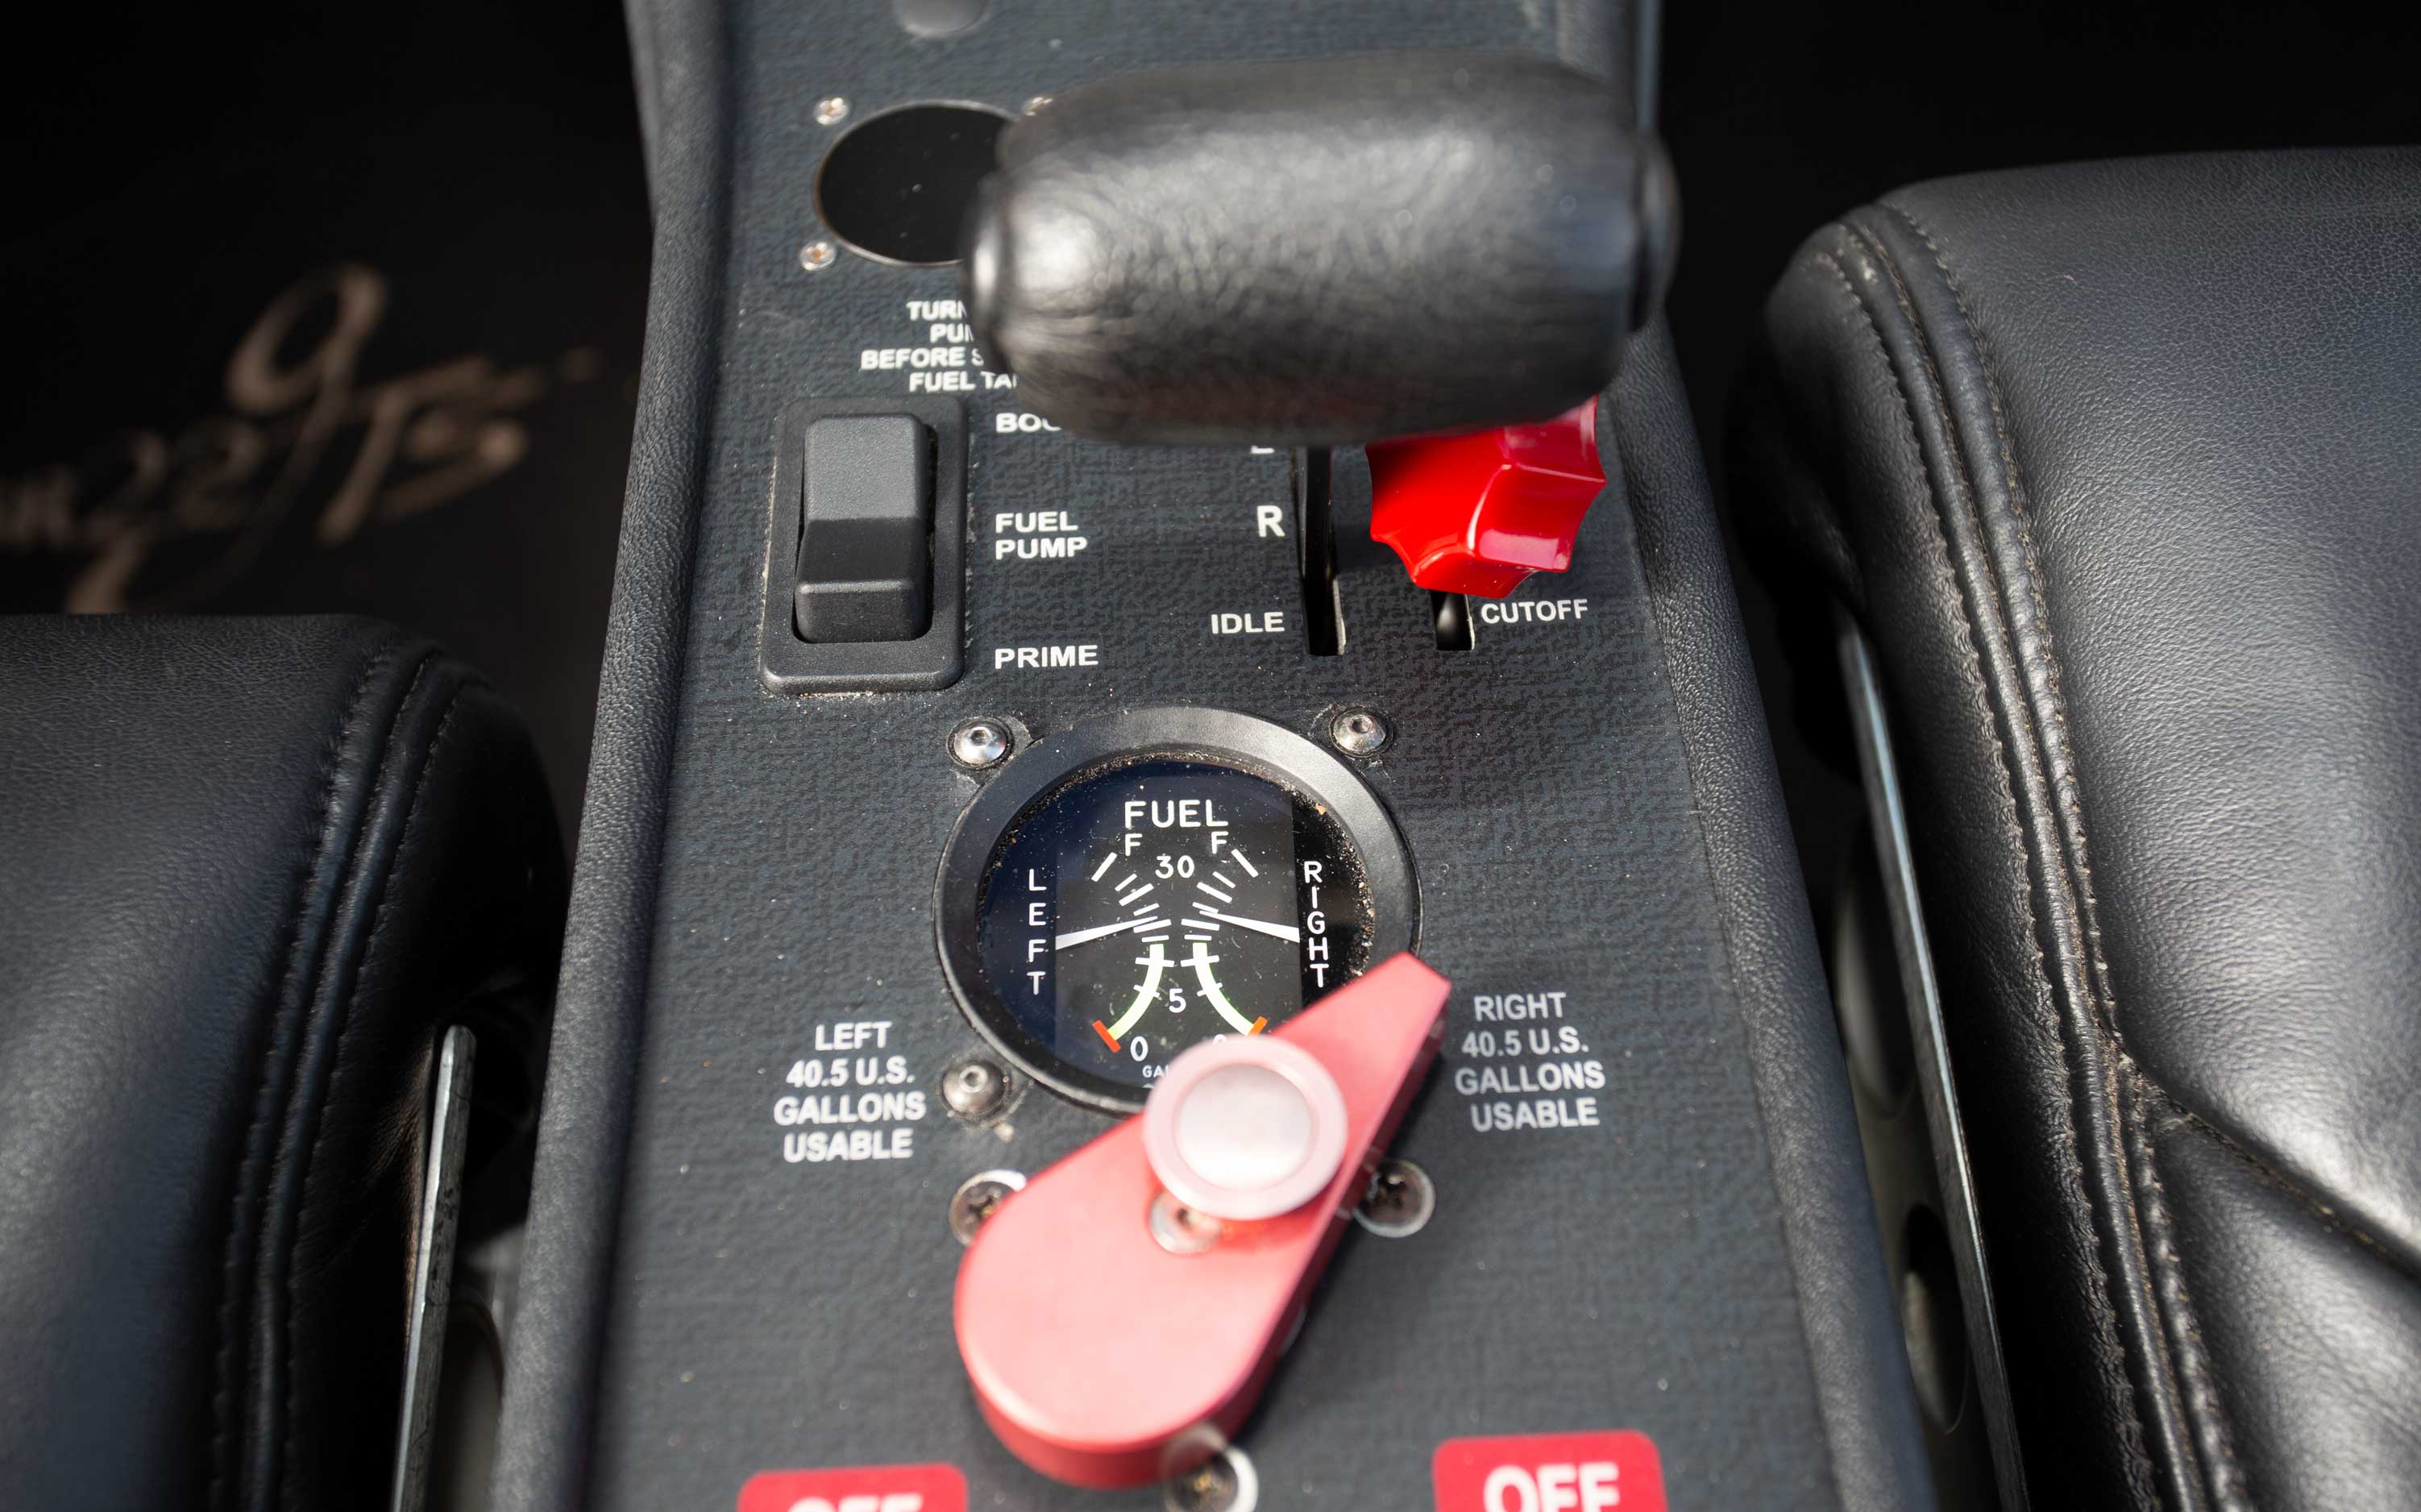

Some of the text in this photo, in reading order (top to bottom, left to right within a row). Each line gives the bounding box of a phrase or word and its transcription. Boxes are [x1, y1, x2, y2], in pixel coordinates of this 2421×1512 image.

[860, 347, 965, 370] BEFORE
[909, 371, 976, 393] FUEL
[995, 511, 1078, 534] FUEL
[1256, 505, 1285, 538] R
[995, 536, 1088, 560] PUMP
[1210, 611, 1285, 634] IDLE
[1480, 599, 1588, 624] CUTOFF
[995, 645, 1099, 669] PRIME
[1124, 799, 1229, 829] FUEL
[1124, 831, 1143, 856] F
[1210, 829, 1229, 854] F
[1154, 854, 1195, 879] 30
[1027, 868, 1047, 995] LEFT
[1303, 860, 1331, 988] RIGHT
[1168, 987, 1187, 1014] 5
[1473, 991, 1567, 1022] RIGHT
[815, 1020, 892, 1051] LEFT
[1130, 1036, 1148, 1061] 0
[1461, 1025, 1589, 1058] 40.5 U.S.
[786, 1055, 916, 1088] 40.5 U.S.
[1454, 1060, 1606, 1095] GALLONS
[773, 1090, 927, 1126] GALLONS
[1470, 1097, 1600, 1132] USABLE
[783, 1128, 914, 1163] USABLE
